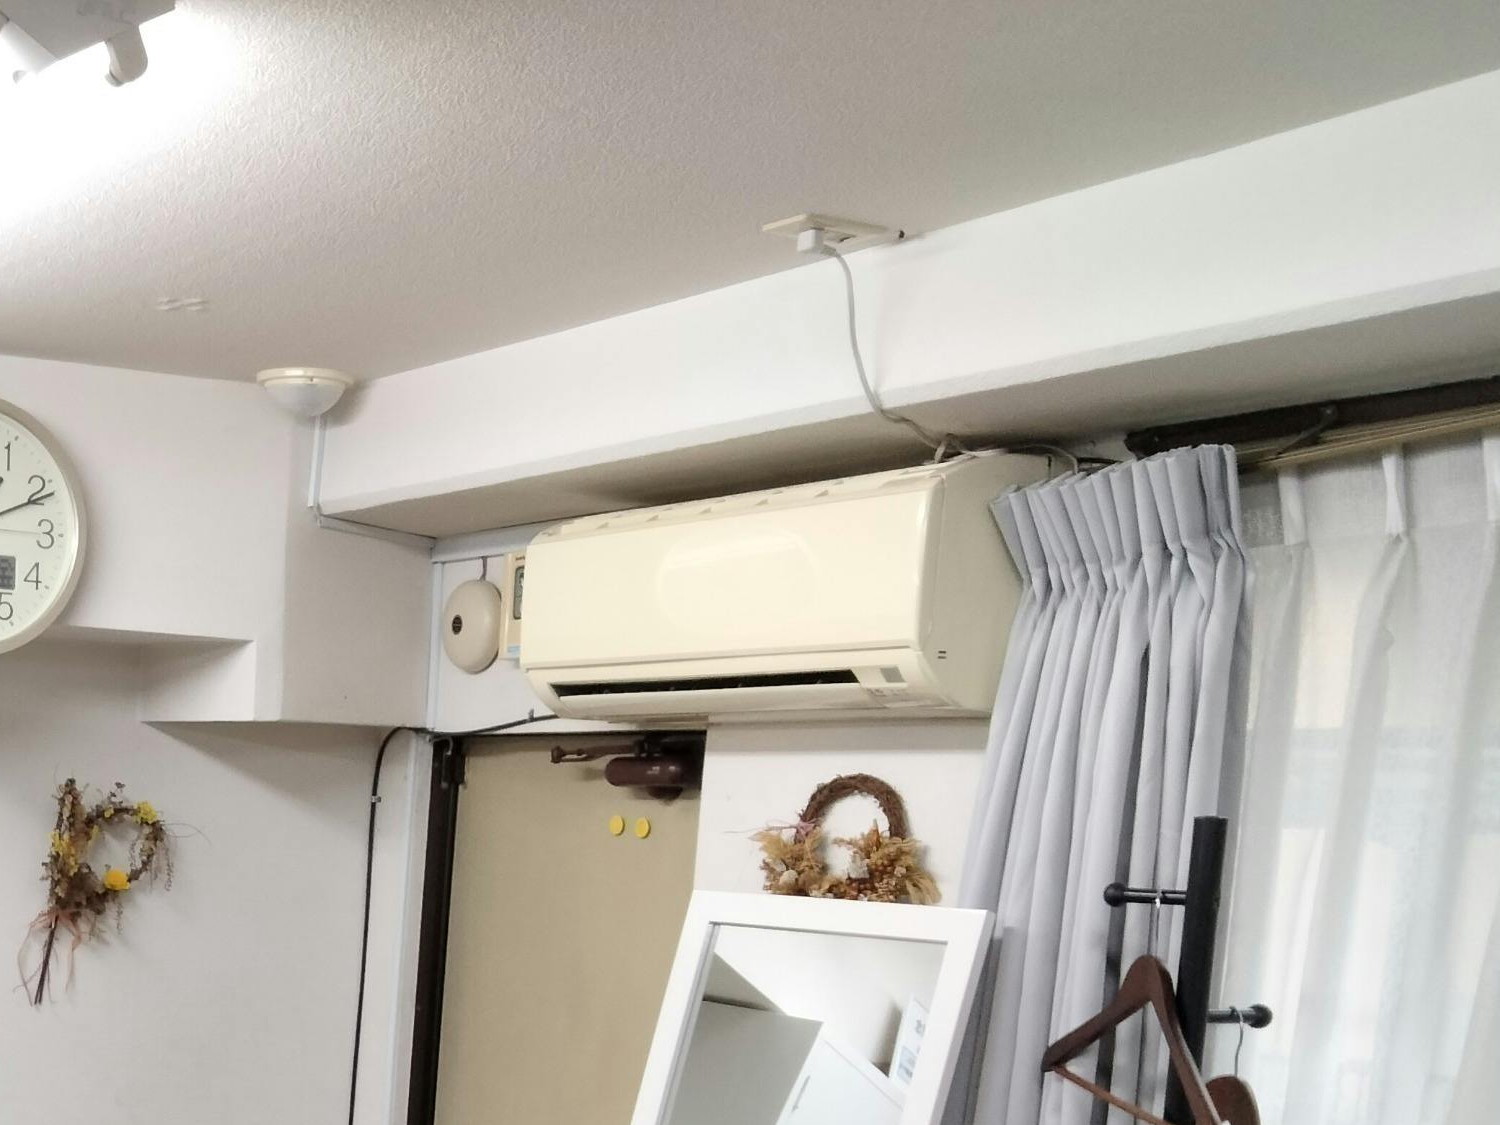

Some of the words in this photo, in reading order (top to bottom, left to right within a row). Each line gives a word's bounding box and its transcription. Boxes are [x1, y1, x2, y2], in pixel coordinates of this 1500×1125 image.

[4, 441, 12, 471] 1
[27, 475, 46, 506] 2
[36, 518, 55, 550] 3
[23, 561, 43, 591] 4
